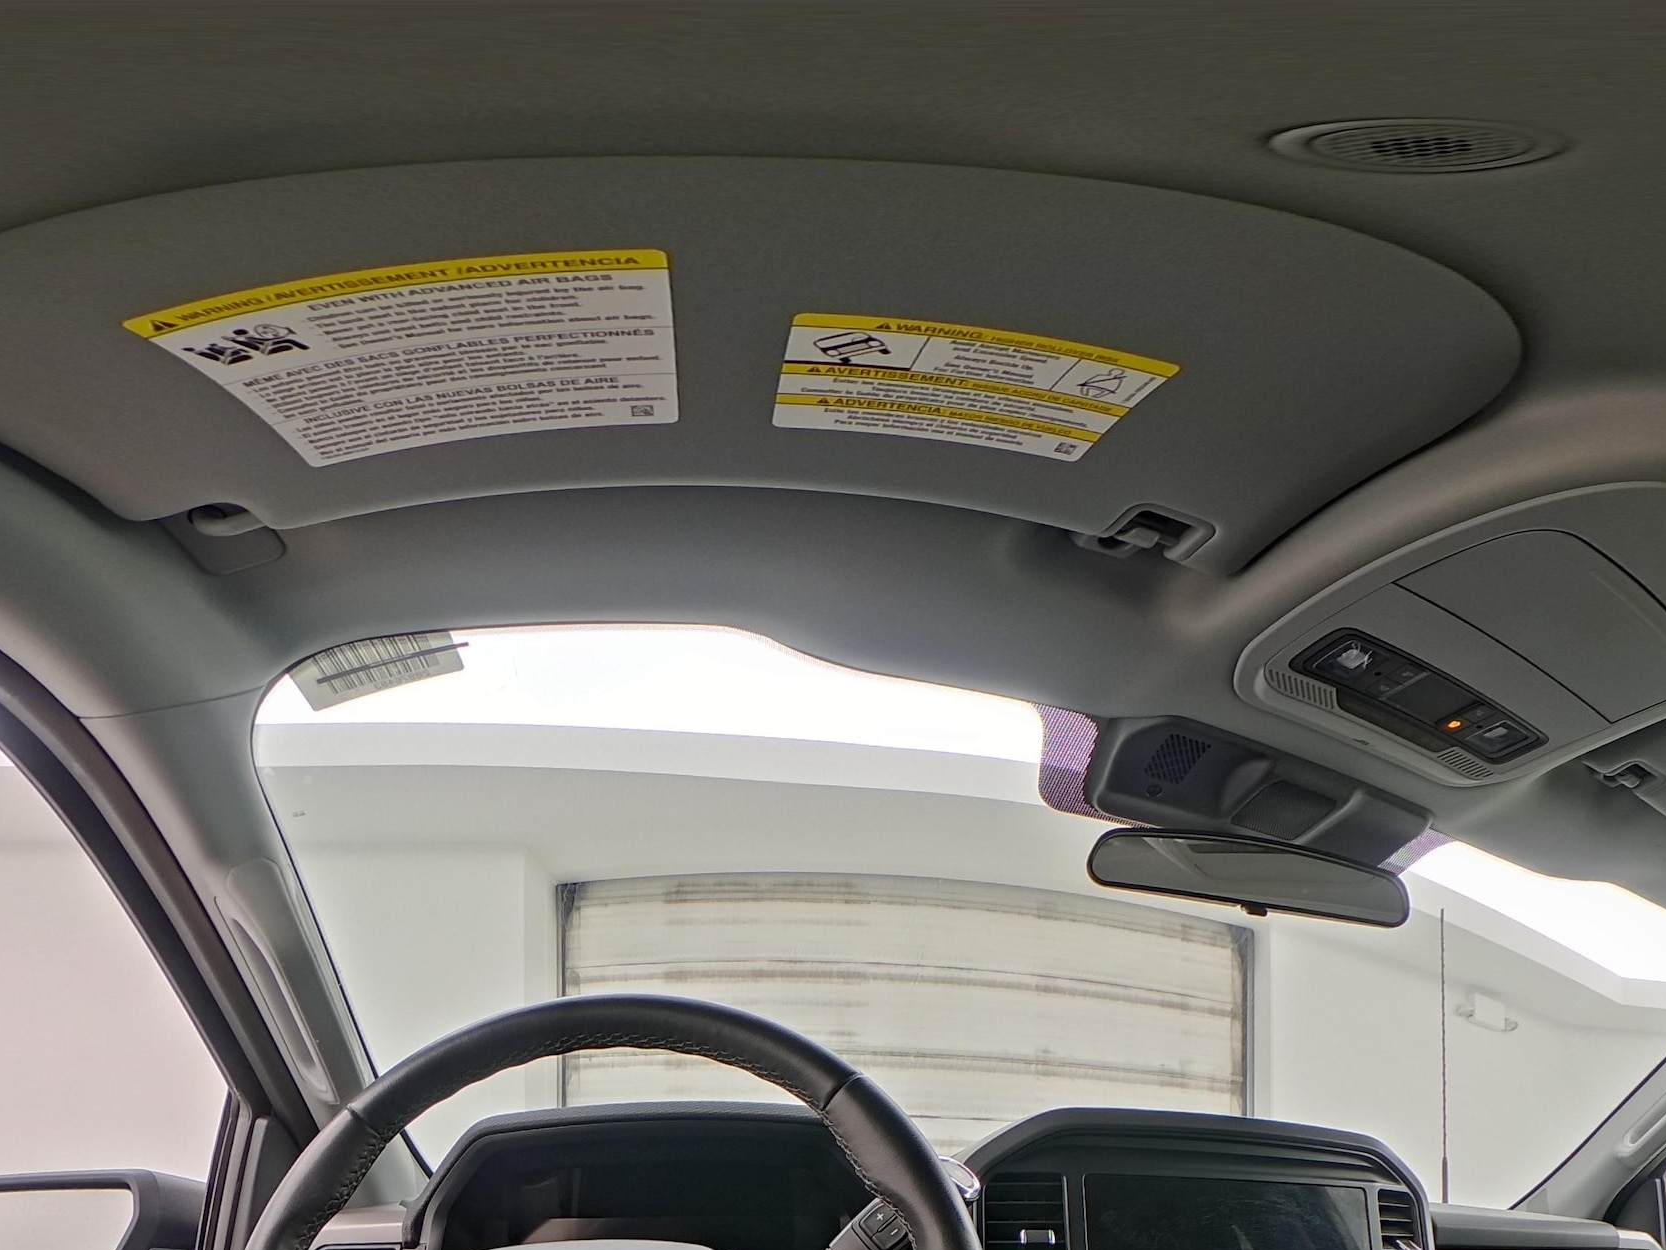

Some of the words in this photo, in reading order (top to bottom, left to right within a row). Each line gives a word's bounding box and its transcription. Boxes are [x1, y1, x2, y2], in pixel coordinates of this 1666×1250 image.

[174, 296, 266, 321] WARNING
[307, 298, 356, 310] EVEN
[357, 291, 406, 302] WITH
[405, 280, 513, 296] ADVANCED
[516, 277, 551, 285] AIR
[555, 274, 614, 283] BAGS
[283, 364, 323, 377] AVEC
[323, 358, 356, 368] DES
[356, 351, 400, 362] SACS
[401, 337, 509, 355] GONFLABLES
[304, 405, 371, 423] INCLUSIVE
[373, 399, 403, 409] CON
[405, 394, 433, 403] LAS
[436, 387, 492, 398] NUEVAS
[497, 381, 556, 391] BOLSAS
